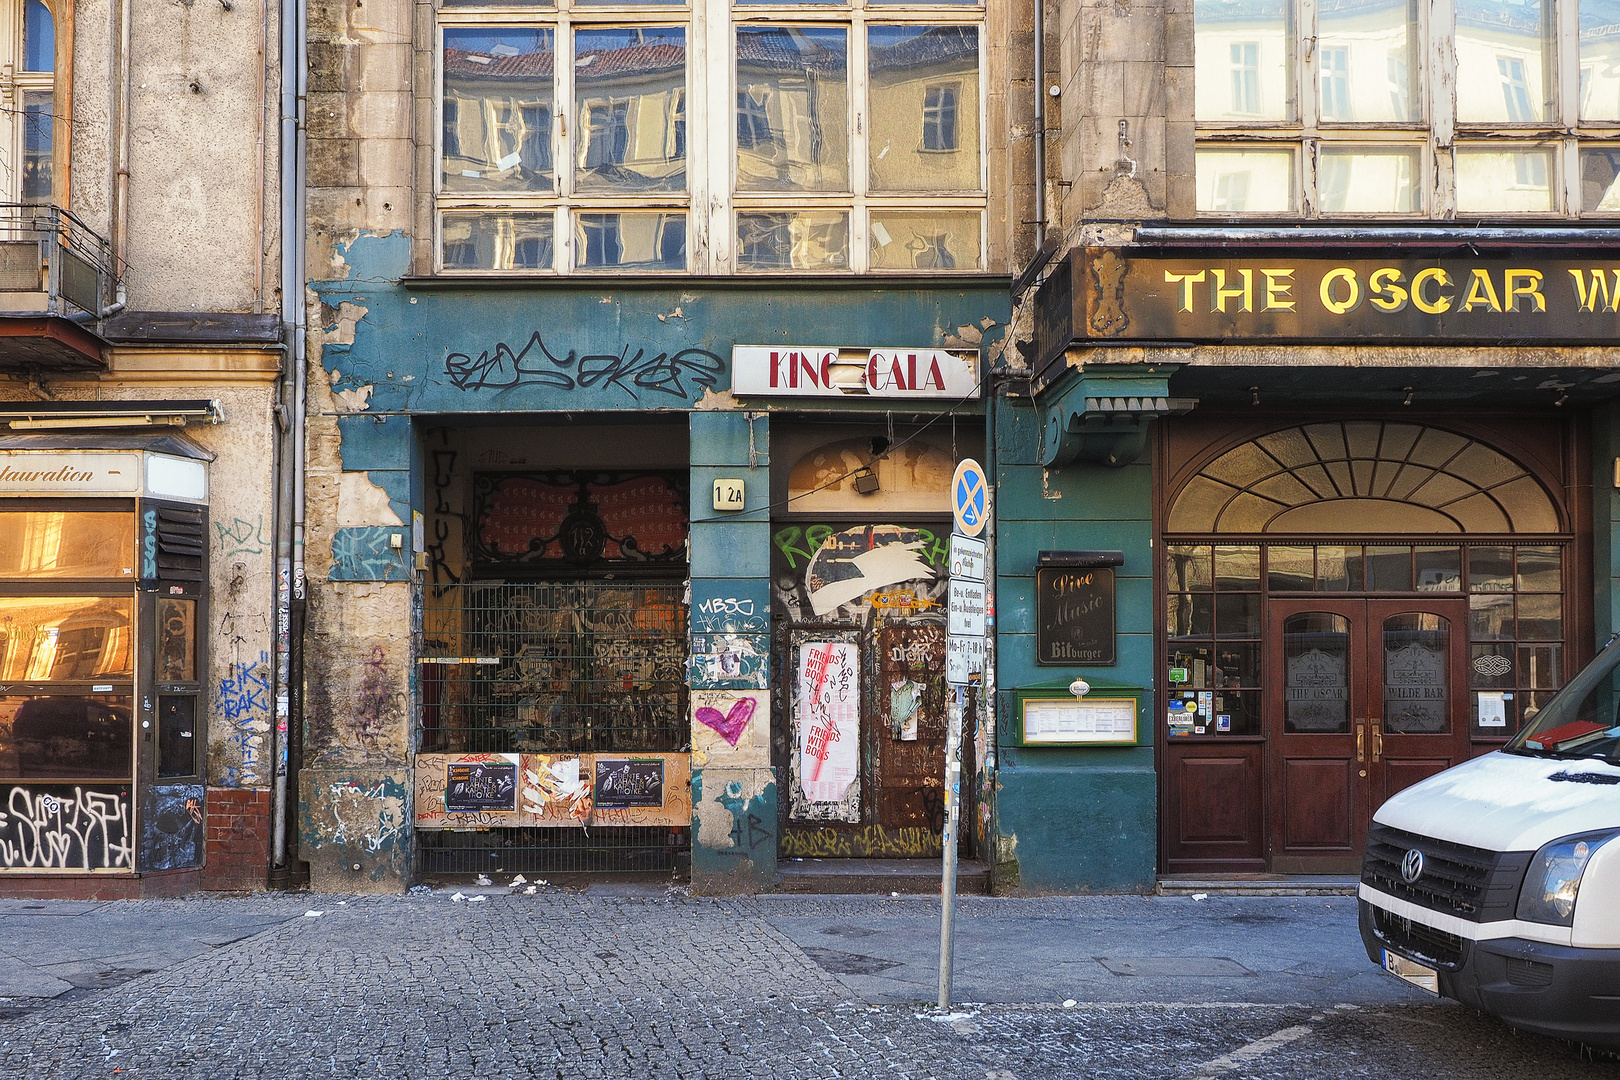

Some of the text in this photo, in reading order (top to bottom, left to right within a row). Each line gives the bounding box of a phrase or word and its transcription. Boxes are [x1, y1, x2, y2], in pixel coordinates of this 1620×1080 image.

[1164, 268, 1297, 314] THE
[1319, 268, 1546, 315] OSCAR
[1053, 572, 1094, 599] Live
[1046, 594, 1104, 630] Music
[808, 648, 840, 665] FRIENDS
[1050, 641, 1102, 660] Bitburger
[807, 658, 826, 674] WITH
[804, 667, 830, 684] BOOKS
[1291, 688, 1343, 699] THE OSCAR
[1388, 687, 1444, 699] WILDE BAR
[809, 725, 841, 743] FRIENDS
[807, 735, 826, 751] WITH
[805, 744, 830, 761] BOOKS
